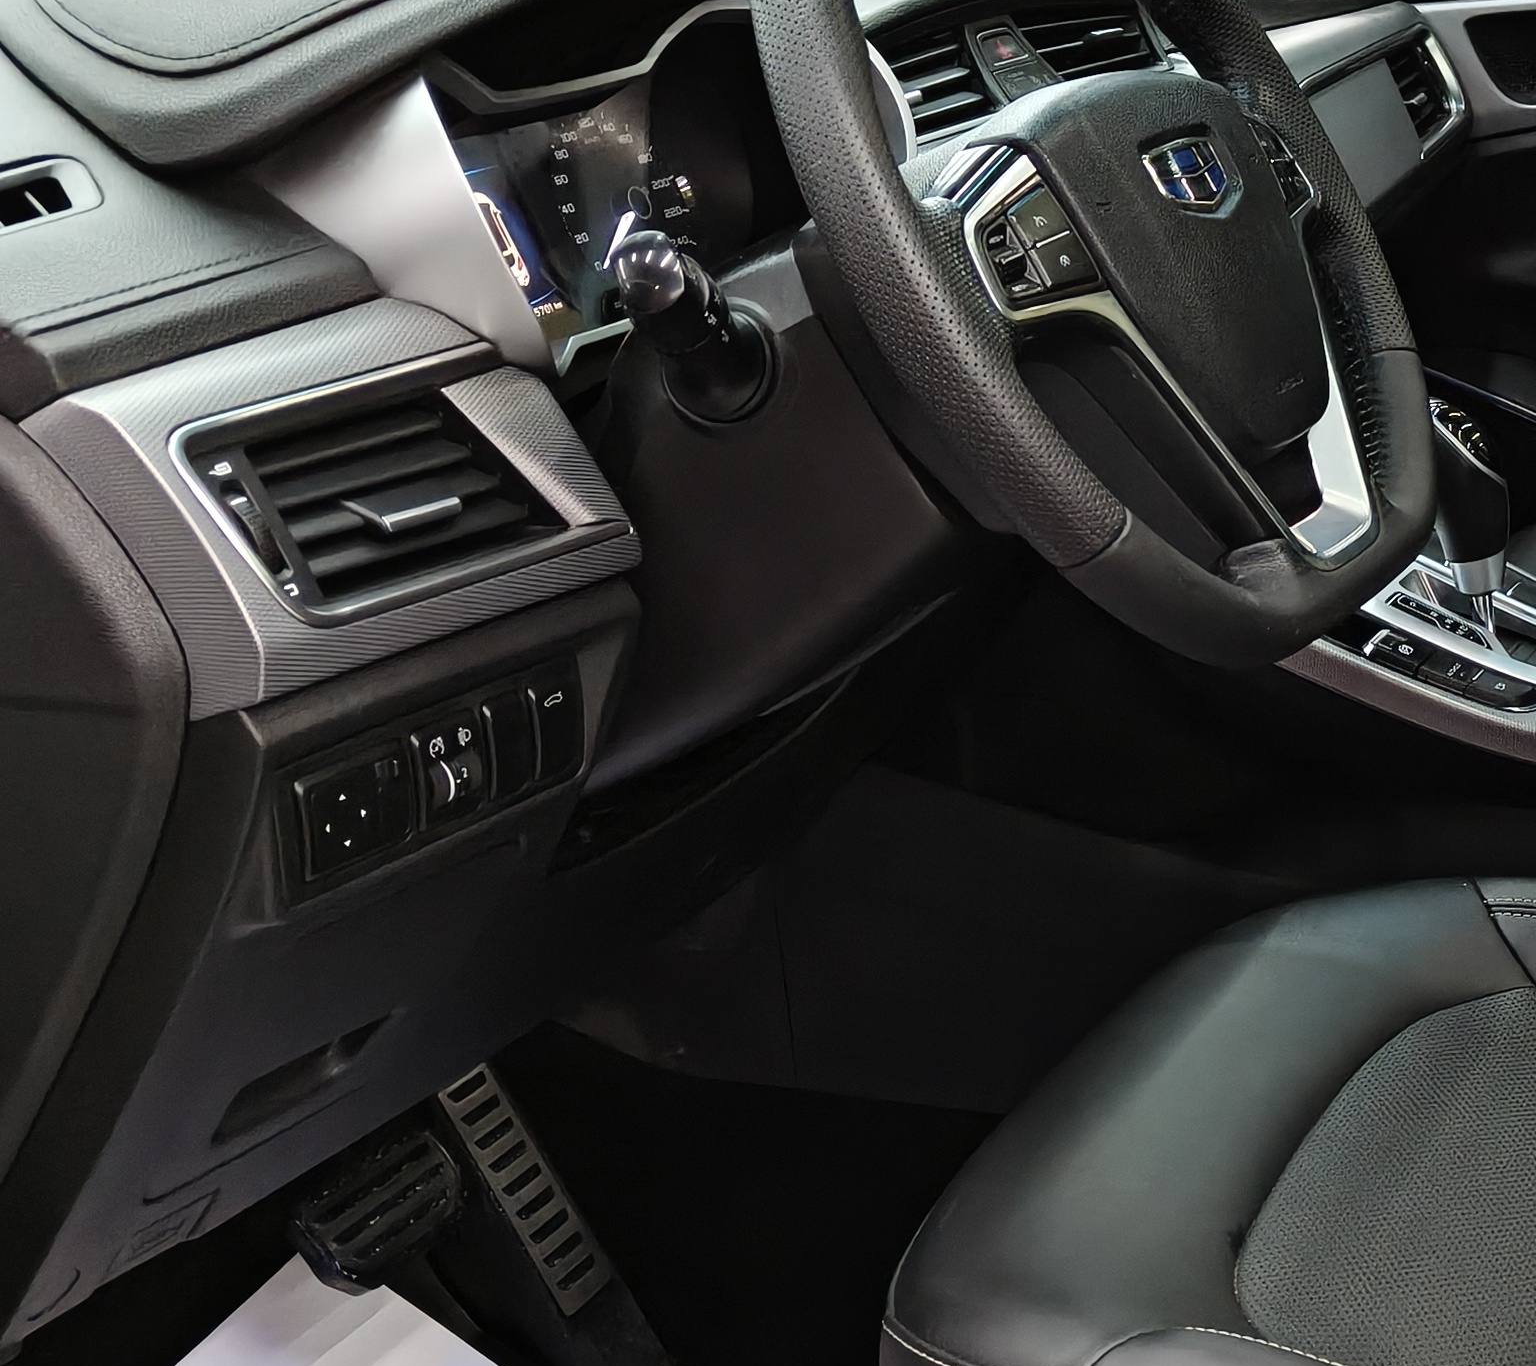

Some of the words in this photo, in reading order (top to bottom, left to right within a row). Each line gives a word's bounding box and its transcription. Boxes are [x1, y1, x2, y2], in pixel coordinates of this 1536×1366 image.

[554, 148, 569, 160] 80
[554, 174, 569, 186] 60
[651, 178, 670, 190] 200
[561, 203, 576, 214] 40
[664, 206, 682, 218] 220
[575, 232, 589, 244] 20
